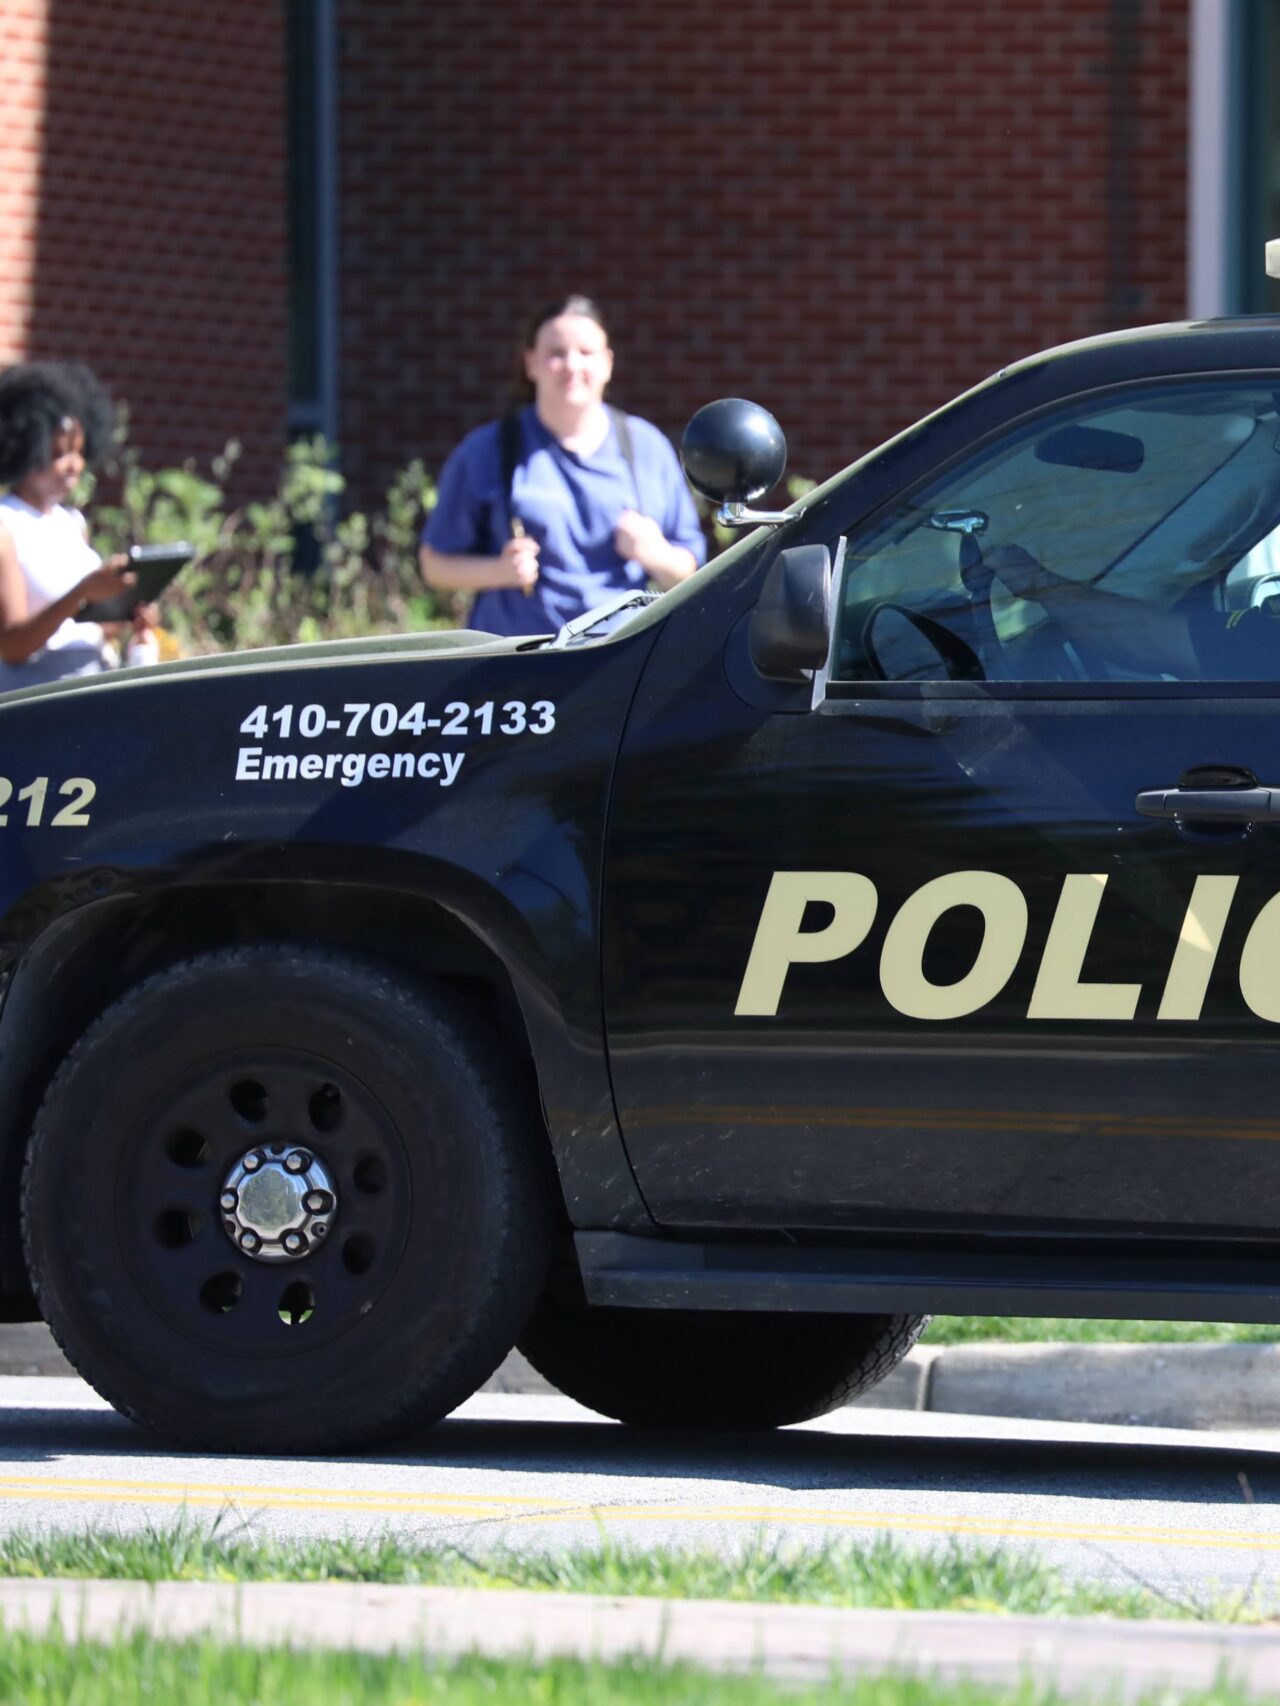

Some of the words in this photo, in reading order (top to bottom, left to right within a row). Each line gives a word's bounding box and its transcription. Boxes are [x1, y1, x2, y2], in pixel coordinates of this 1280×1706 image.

[239, 700, 557, 739] 410-704-2133
[235, 746, 466, 788] Emergency
[0, 776, 97, 827] 12
